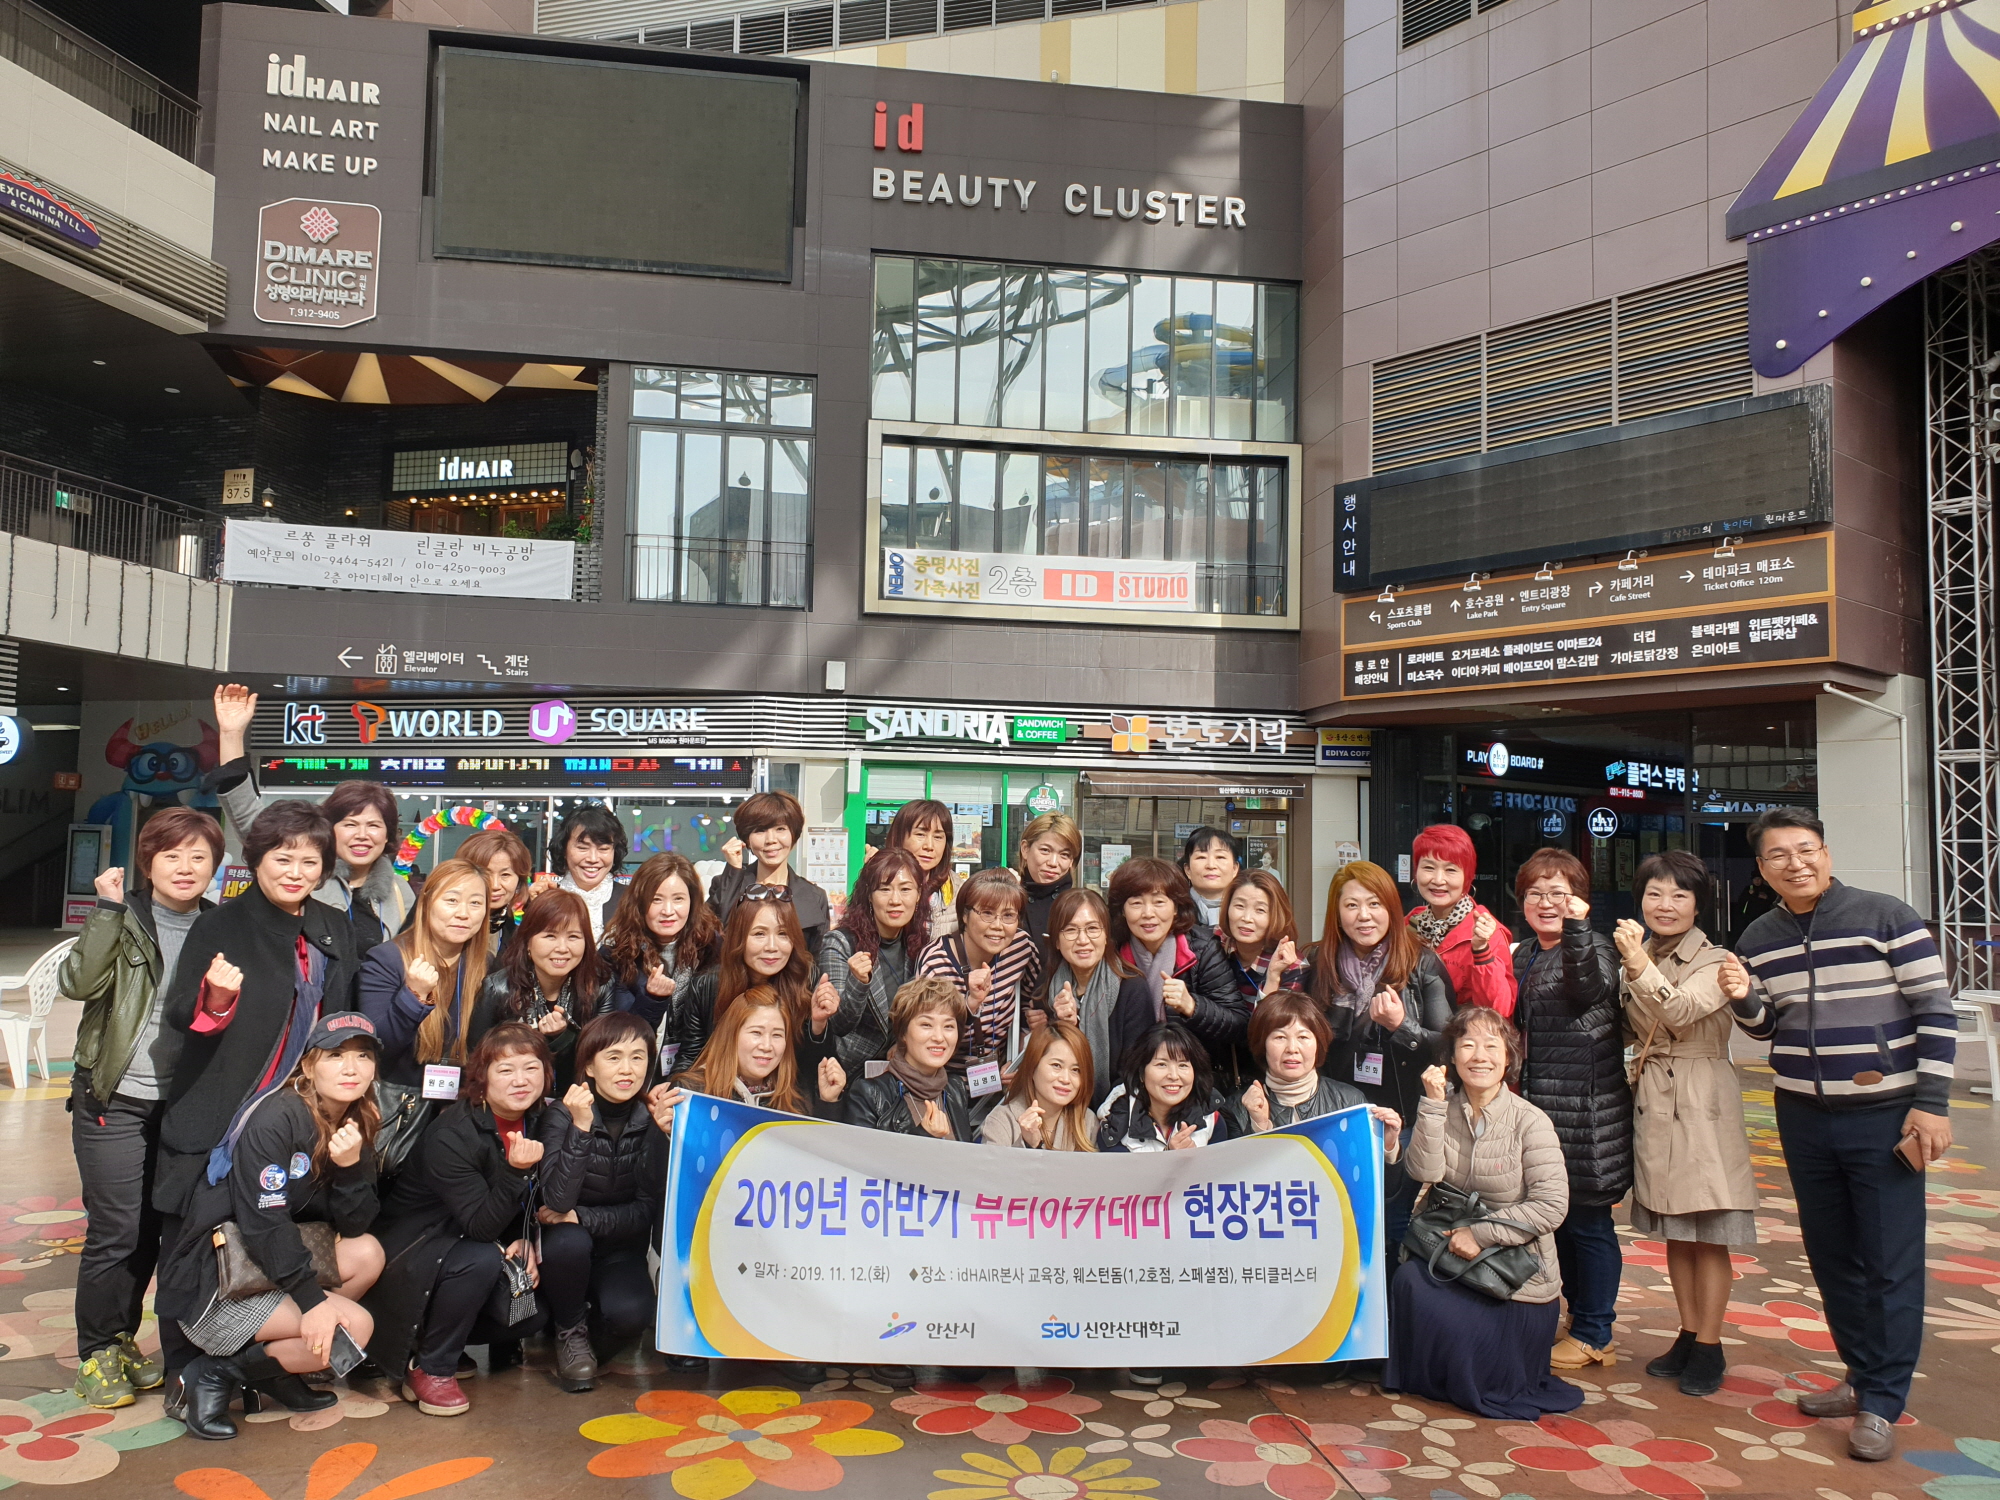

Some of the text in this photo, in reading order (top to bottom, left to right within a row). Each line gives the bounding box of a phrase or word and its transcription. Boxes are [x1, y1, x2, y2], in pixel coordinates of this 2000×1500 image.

[267, 53, 380, 105] idHAIR
[264, 112, 379, 140] NAIL ART
[873, 101, 924, 152] id
[262, 148, 378, 176] MAKE UP
[872, 166, 1247, 228] BEAUTY CLUSTER
[19, 204, 60, 228] CANTINA
[264, 240, 372, 270] DIMARE
[266, 262, 357, 289] CLINIC
[264, 284, 366, 307] 성형외과/피부과
[289, 308, 340, 320] T.912-9405
[439, 456, 513, 481] idHAIR
[226, 488, 250, 499] 37.5
[1723, 518, 1753, 531] 놀이터
[1764, 510, 1808, 524] 원마운트
[284, 530, 316, 548] 르쏭
[417, 536, 464, 558] 린클랑
[473, 542, 535, 562] 비누공방
[247, 547, 295, 564] 예약문의
[302, 552, 393, 568] 010-9464-5421
[415, 560, 506, 576] 010-4250-9003
[914, 555, 980, 577] 증명사진
[1703, 557, 1795, 580] 테마파크 매표소
[324, 571, 482, 589] 2층 아이디헤어 안으로 오세요
[888, 552, 904, 596] OPEN
[988, 565, 1037, 598] 2층
[1609, 574, 1654, 591] 카페거리
[1703, 575, 1783, 592] Ticket Office 120m
[914, 578, 980, 600] 가족사진
[1061, 572, 1188, 599] ID STUDIO
[1519, 584, 1571, 603] 엔트리광장
[1465, 594, 1504, 610] 호수공원
[1521, 601, 1566, 615] Entry Square
[1609, 591, 1651, 603] Cafe Street
[1387, 603, 1432, 620] 스포츠클럽
[1466, 609, 1499, 620] Lake Park
[1387, 618, 1423, 631] Sports Club
[1407, 651, 1444, 665] 로라비트
[1451, 646, 1501, 662] 요거프레소
[1503, 641, 1554, 657] 플레이보드
[1557, 636, 1602, 651] 이마트24
[1633, 630, 1656, 644] 더컵
[1691, 621, 1740, 639] 블랙라벨
[403, 651, 465, 665] 엘리베이터
[505, 654, 529, 668] 계단
[1354, 642, 1741, 686] 매장안내 미소국수 이디야 커피 베이프모어 맘스김밥 가마로닭강정 은미아트
[404, 665, 438, 674] Elevator
[506, 668, 529, 677] Stairs
[284, 702, 327, 745] kt
[389, 709, 505, 738] WORLD
[590, 707, 708, 737] SQUARE
[865, 707, 1010, 747] SANDRIA
[1017, 719, 1063, 729] SANDWICH
[1017, 730, 1058, 739] & COFFEE
[1157, 715, 1293, 755] 본도시락
[1325, 749, 1349, 757] EDIYA
[1467, 750, 1489, 763] PLAY
[1627, 762, 1663, 787] 플러스
[734, 1176, 1320, 1241] 2019년 하반기 뷰티아카데미 현장견학
[753, 1261, 779, 1279] 일자
[791, 1266, 825, 1281] 2019.
[829, 1267, 846, 1281] 11.
[850, 1265, 891, 1284] 12.(화)
[920, 1266, 946, 1283] 장소
[957, 1266, 1025, 1284] idHAIR본사
[1028, 1267, 1069, 1286] 교육장,
[1073, 1266, 1175, 1286] 웨스턴돔(1,2호점,
[1178, 1266, 1239, 1286] 스페셜점),
[1241, 1266, 1318, 1284] 뷰티클러스터
[926, 1321, 975, 1339] 안산시
[1084, 1320, 1181, 1339] 신안산대학교
